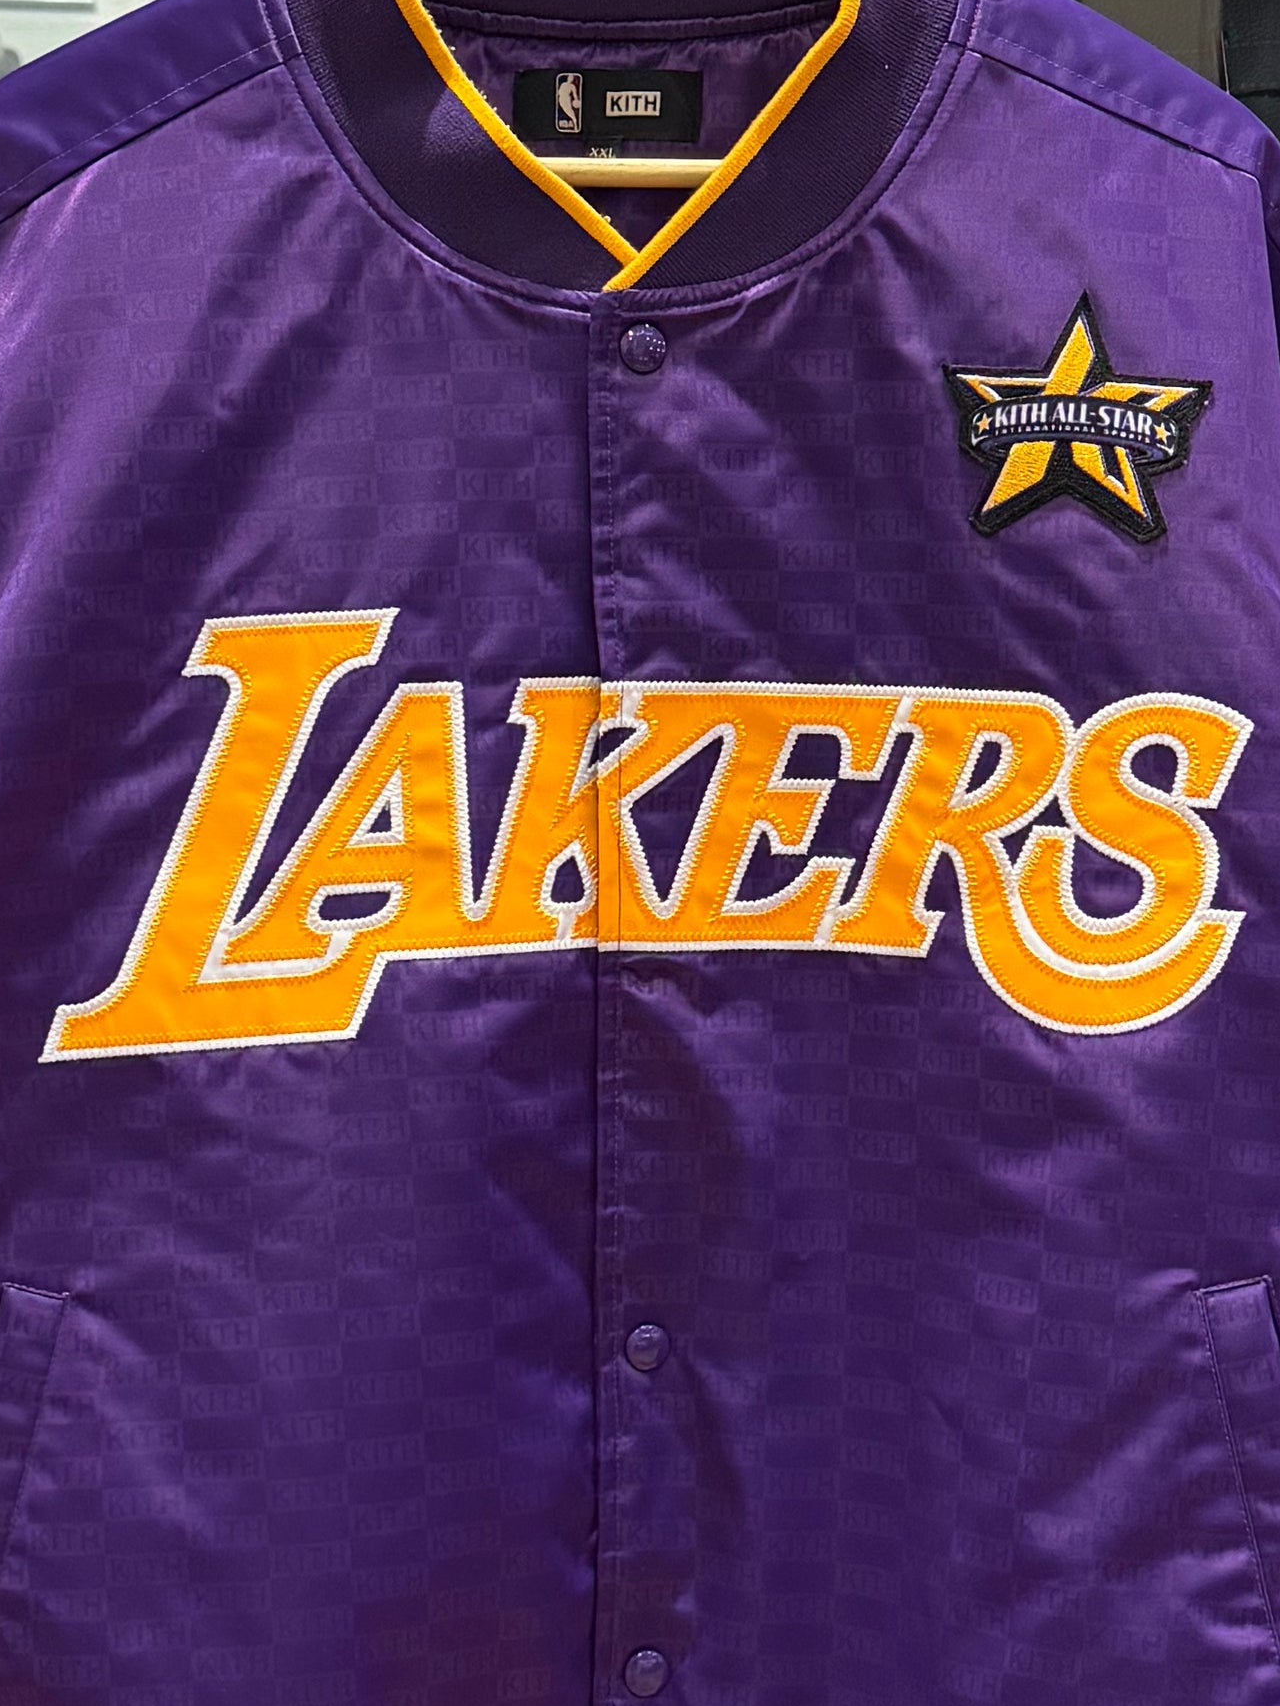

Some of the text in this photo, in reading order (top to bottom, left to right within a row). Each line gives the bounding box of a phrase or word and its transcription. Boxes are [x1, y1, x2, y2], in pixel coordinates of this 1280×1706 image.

[610, 95, 657, 112] KITH
[994, 402, 1154, 436] KITH ALL-STAR
[38, 606, 1256, 1064] LAKERS
